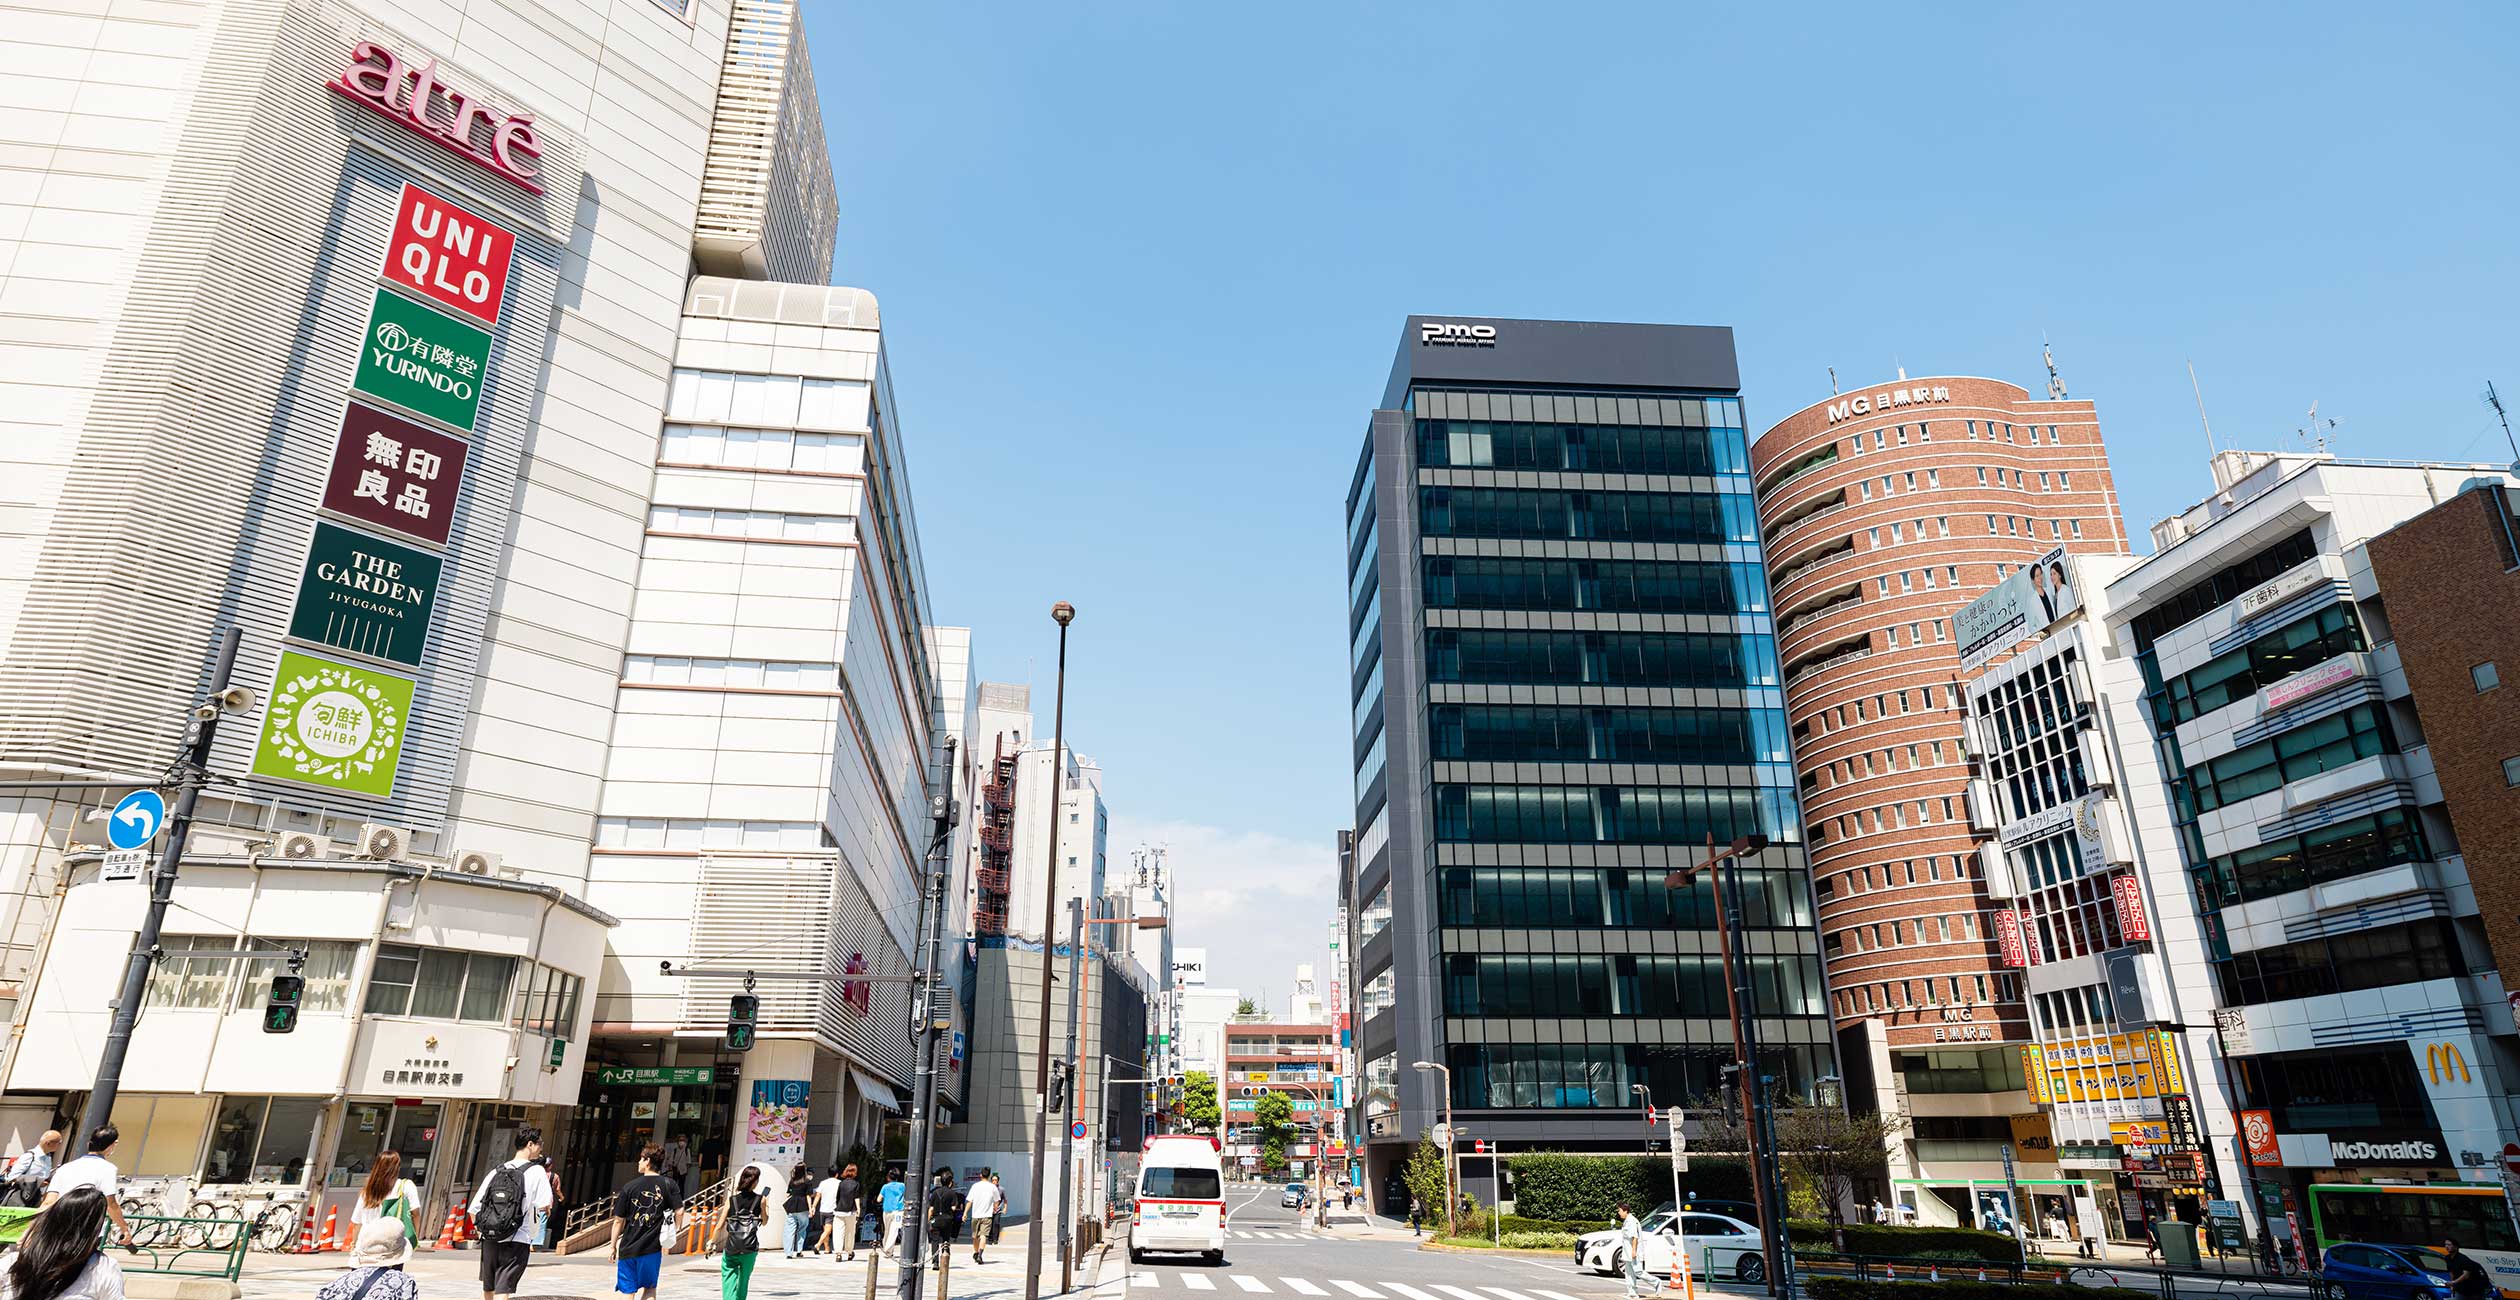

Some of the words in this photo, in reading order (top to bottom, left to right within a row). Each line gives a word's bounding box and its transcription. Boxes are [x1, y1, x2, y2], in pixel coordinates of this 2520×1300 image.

[340, 40, 544, 179] atré
[411, 202, 493, 264] UNI
[402, 243, 491, 304] QLO
[1421, 323, 1497, 342] pmo
[408, 337, 478, 380] 有隣堂
[372, 347, 472, 400] YURINDO
[1827, 395, 1871, 423] MG
[1876, 386, 1950, 409] 目黒駅前
[366, 431, 441, 482] 無印
[353, 469, 431, 520] 良品
[351, 550, 403, 580] THE
[317, 562, 424, 606] GARDEN
[2257, 583, 2280, 605] 歯科
[328, 591, 405, 619] JIYUGAOKA
[1969, 599, 2017, 639] かかりつけ
[312, 701, 364, 732] 旬鮮
[307, 726, 357, 746] ICHIBA
[105, 864, 141, 873] 一方通行
[1944, 1008, 1973, 1023] MG
[1935, 1025, 1992, 1042] 目黒駅前
[383, 1070, 464, 1086] 目黒駅前交番
[616, 1069, 634, 1080] JR
[635, 1069, 659, 1078] 目黒駅
[733, 1067, 740, 1075] a
[2076, 1074, 2149, 1093] タウンハウジング
[2178, 1100, 2196, 1145] 餃子酒場
[2332, 1141, 2438, 1160] McDonald's
[1158, 1204, 1203, 1212] 東京消防庁
